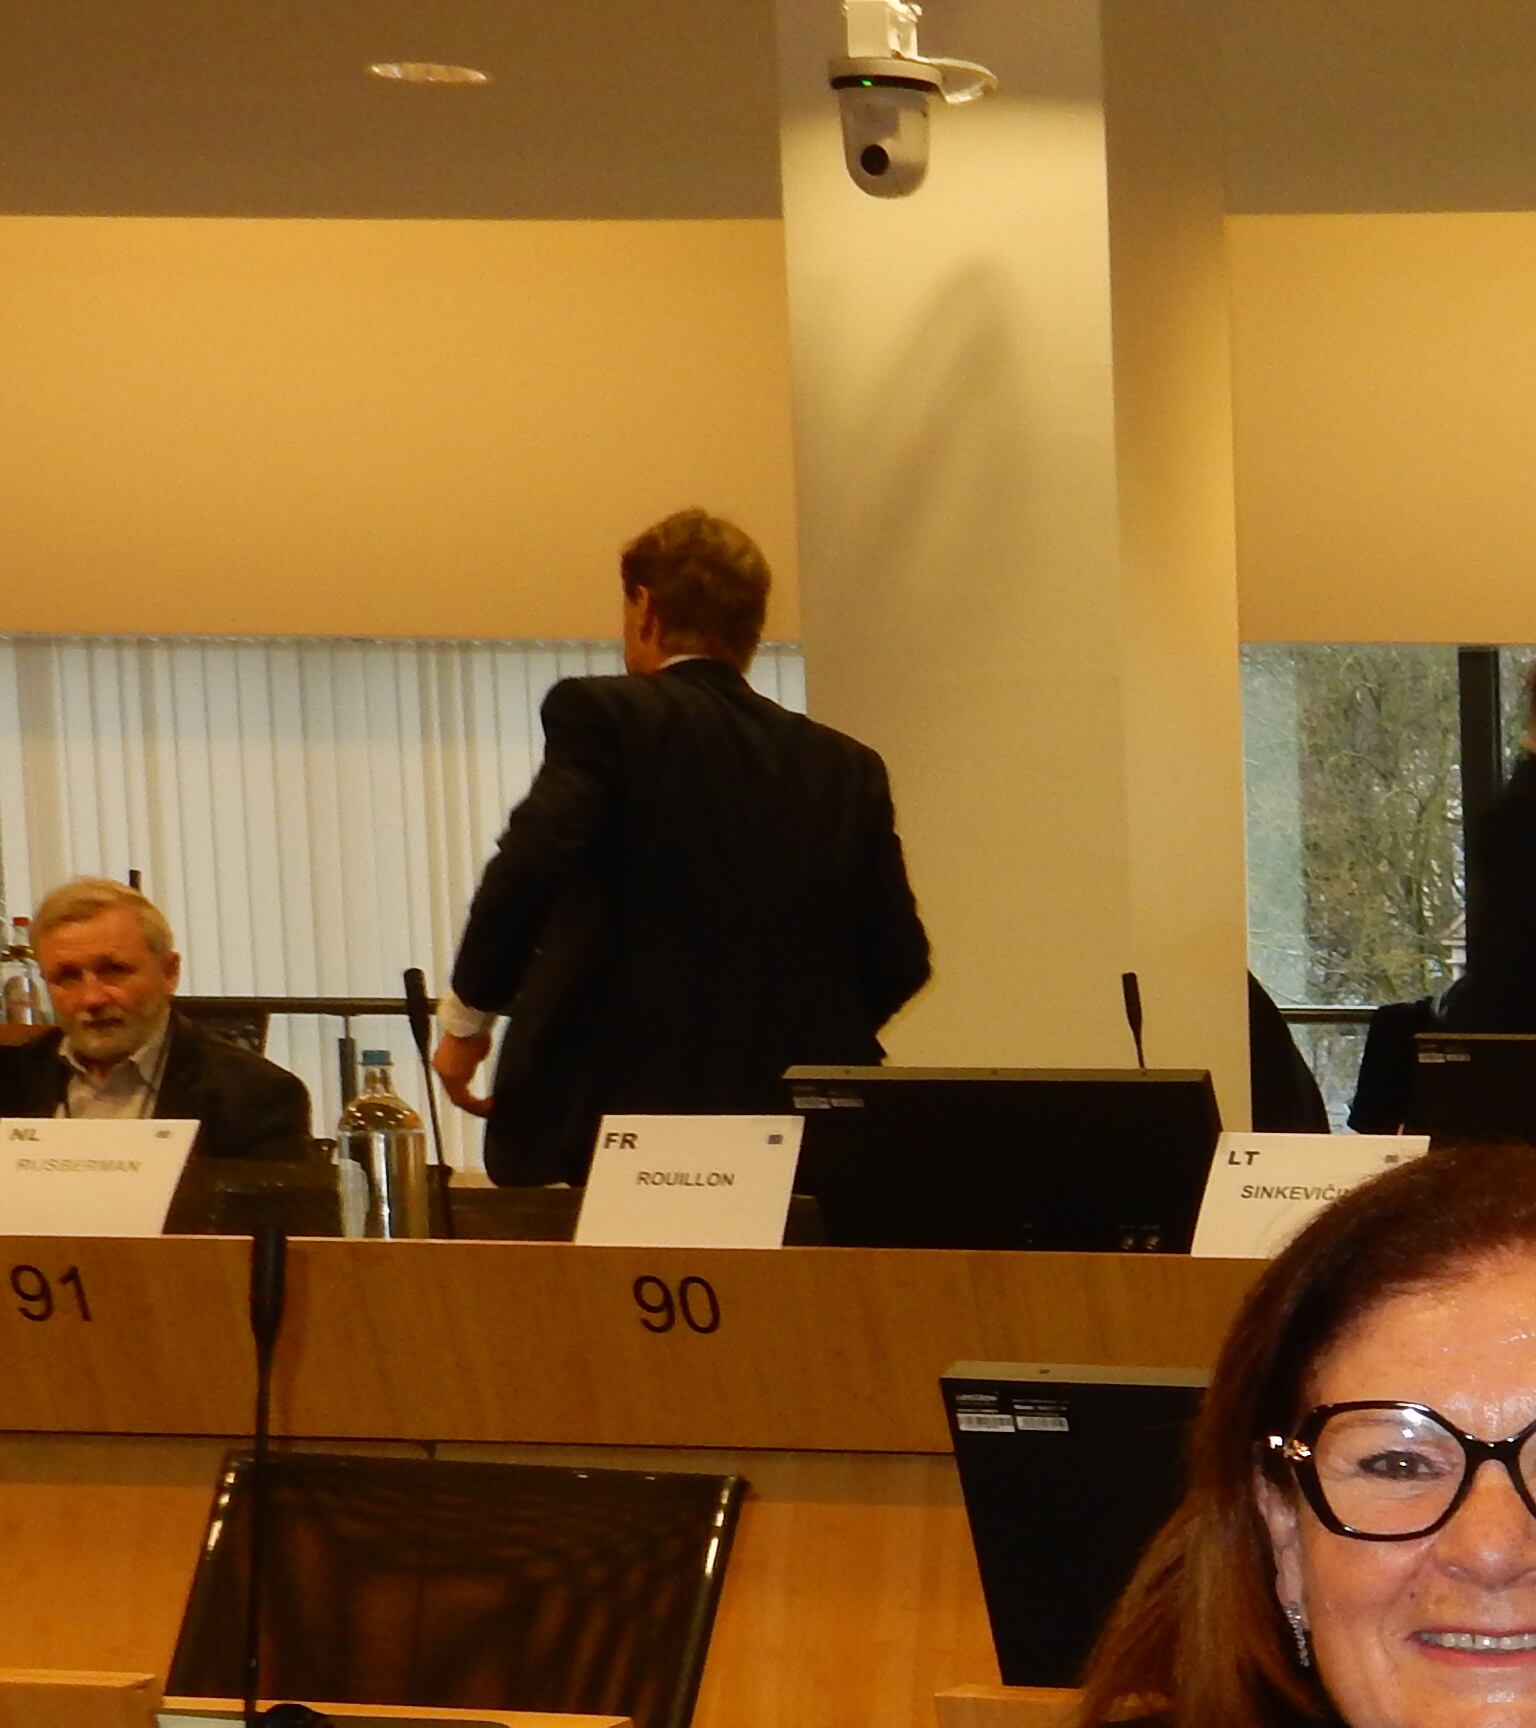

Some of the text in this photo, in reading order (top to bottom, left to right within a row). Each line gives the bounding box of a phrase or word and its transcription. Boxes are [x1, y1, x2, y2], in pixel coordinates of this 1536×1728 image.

[603, 1132, 638, 1150] FR
[1228, 1151, 1260, 1166] LT
[636, 1170, 735, 1188] ROUILLON
[10, 1263, 94, 1324] 91
[631, 1274, 724, 1335] 90
